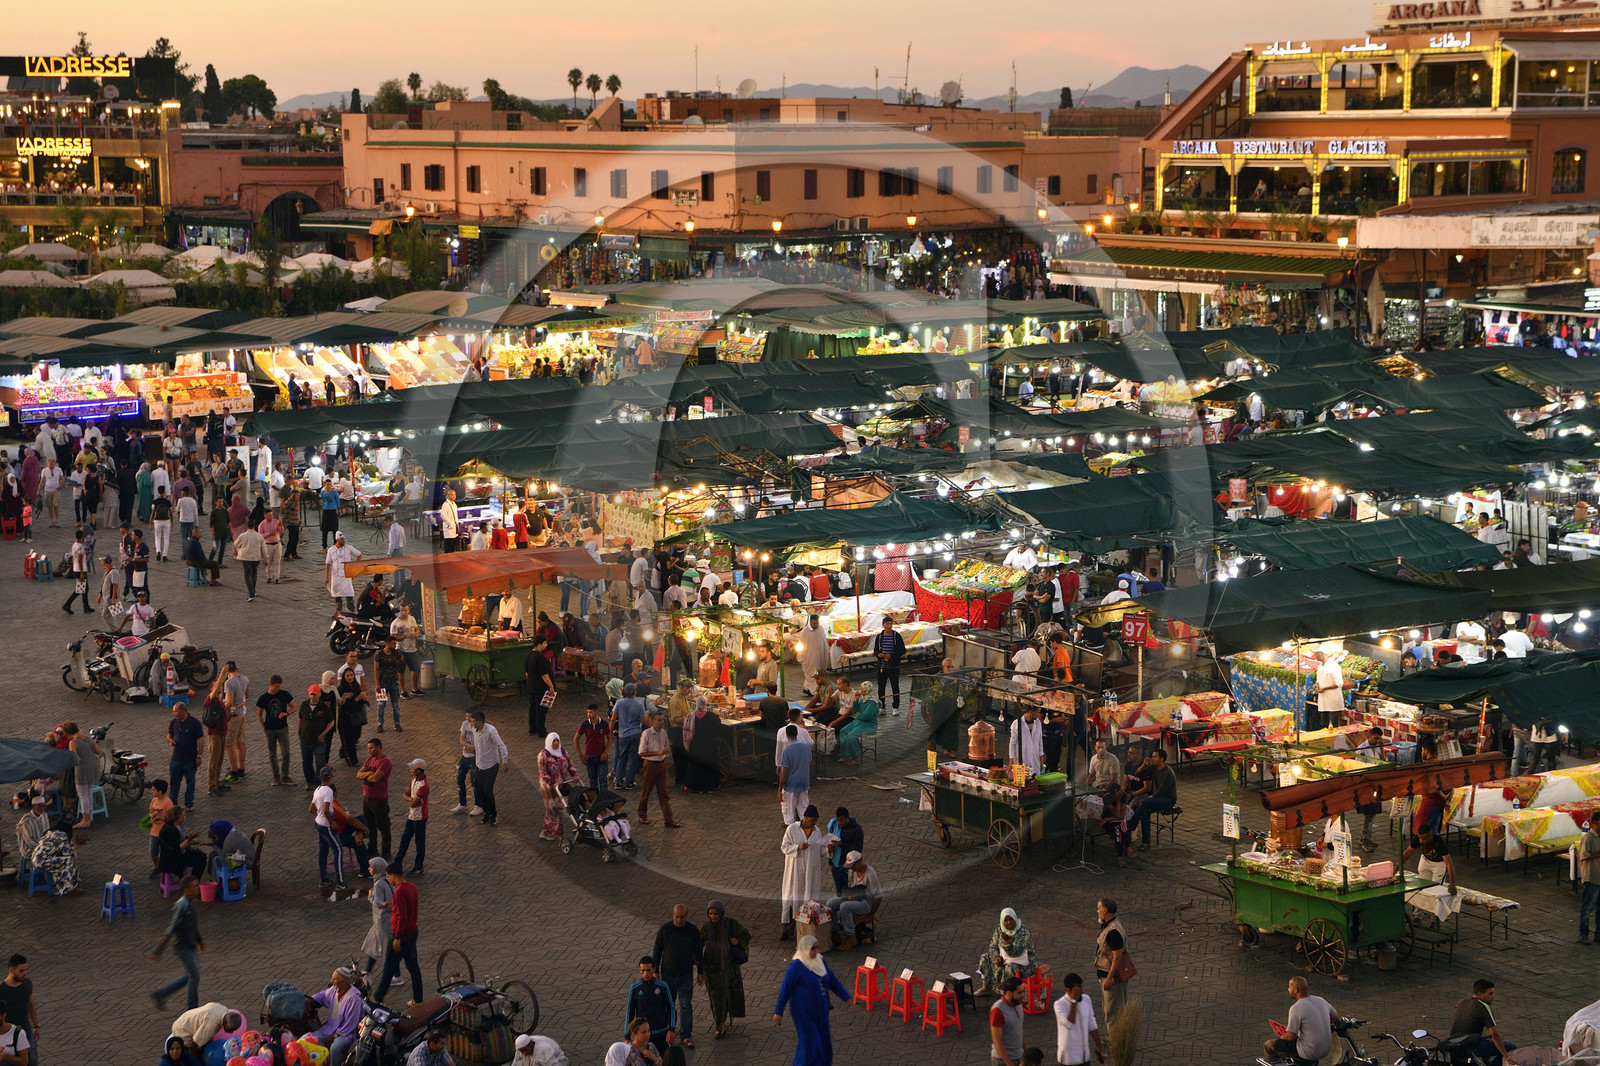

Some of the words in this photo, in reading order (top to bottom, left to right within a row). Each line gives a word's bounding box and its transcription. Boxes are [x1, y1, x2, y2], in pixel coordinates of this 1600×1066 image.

[1387, 0, 1481, 20] ARGANA
[25, 55, 131, 78] L'ADRESSE
[16, 137, 92, 151] L'ADRESSE
[1172, 141, 1218, 155] ARGANA
[1233, 141, 1314, 155] RESTAURANT
[1328, 140, 1387, 155] GLACIER
[1059, 358, 1070, 368] 22
[714, 555, 729, 568] 29
[1124, 620, 1146, 638] 97
